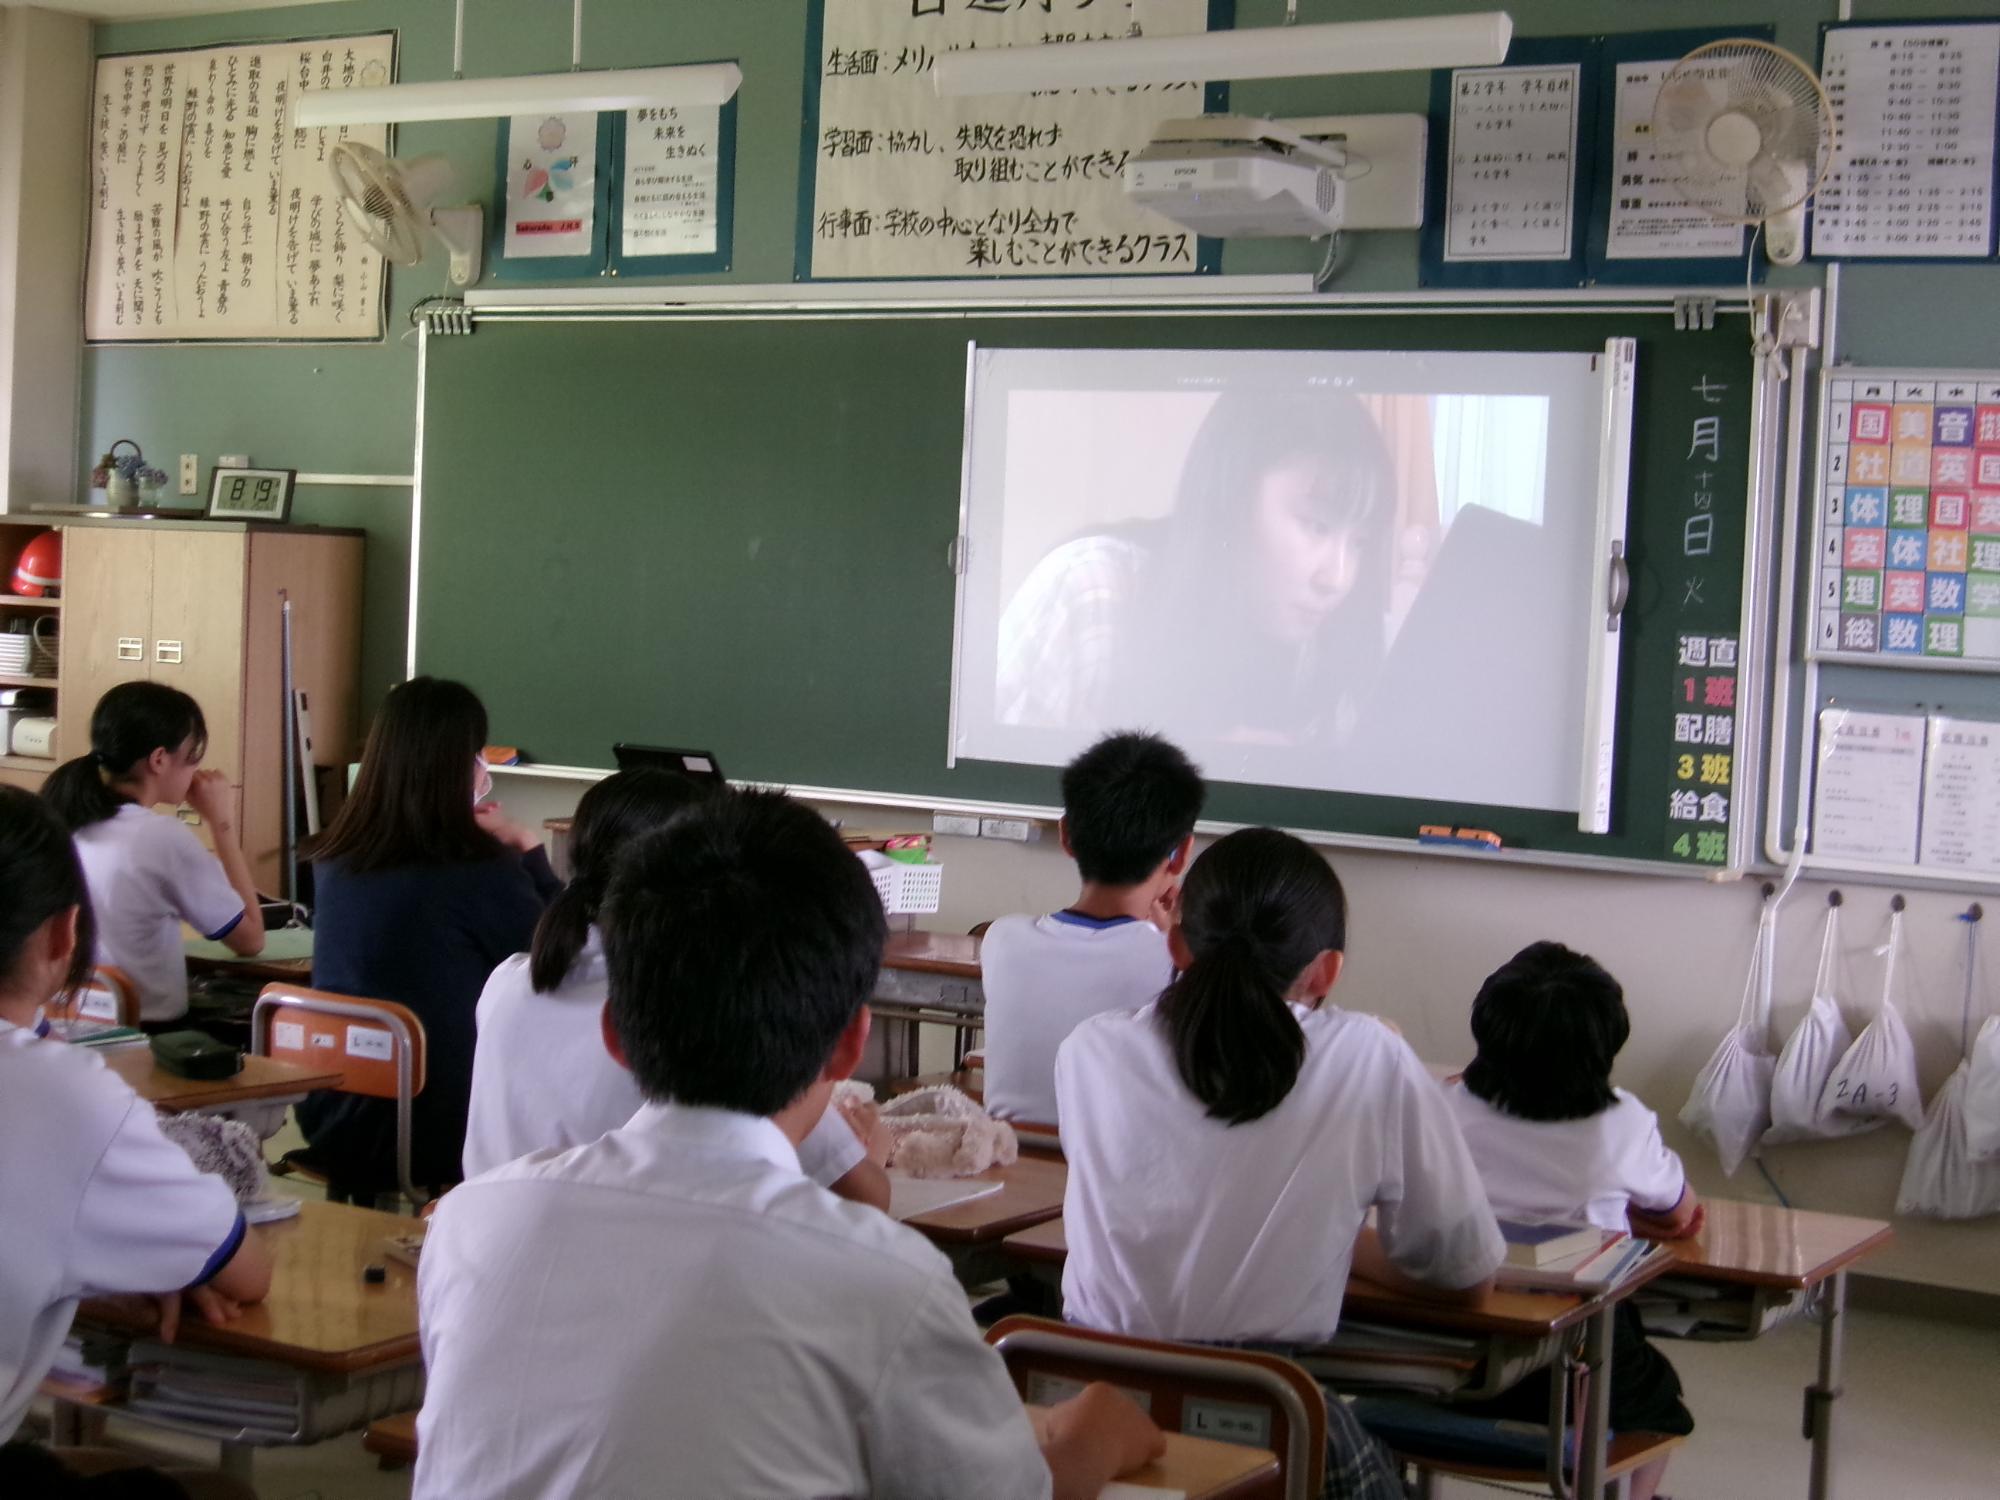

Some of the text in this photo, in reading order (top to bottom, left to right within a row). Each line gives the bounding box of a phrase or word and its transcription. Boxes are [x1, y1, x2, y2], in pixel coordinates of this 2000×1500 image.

[637, 107, 678, 122] 夢をもち
[653, 126, 685, 140] 未来を
[665, 144, 705, 160] 生きぬく
[1174, 167, 1197, 176] EPSON
[966, 233, 1191, 269] 楽しむことができるクラス
[1866, 386, 1881, 397] 月
[1907, 386, 1923, 397] 火
[1949, 386, 1964, 398] 水
[1837, 412, 1843, 431] 1
[1855, 408, 1886, 440] 国
[1938, 411, 1969, 443] 音
[1833, 455, 1842, 472] 2
[1854, 451, 1884, 481] 社
[1937, 452, 1968, 484] 英
[1832, 497, 1839, 514] 3
[1850, 493, 1881, 524] 体
[1894, 494, 1924, 525] 理
[1934, 496, 1965, 526] 国
[1829, 533, 2000, 571] 4 英 体 社 理
[1828, 581, 1836, 597] 5
[1844, 575, 1875, 605] 理
[1890, 577, 1920, 608] 英
[1930, 576, 1961, 609] 数
[1826, 616, 1959, 653] 6 総 数 理
[1678, 635, 1737, 669] 週直
[1684, 675, 1735, 707] 1班
[1674, 713, 1733, 745] 配膳
[1676, 752, 1731, 785] 3班
[1669, 788, 1729, 824] 給食
[1673, 830, 1726, 862] 4班
